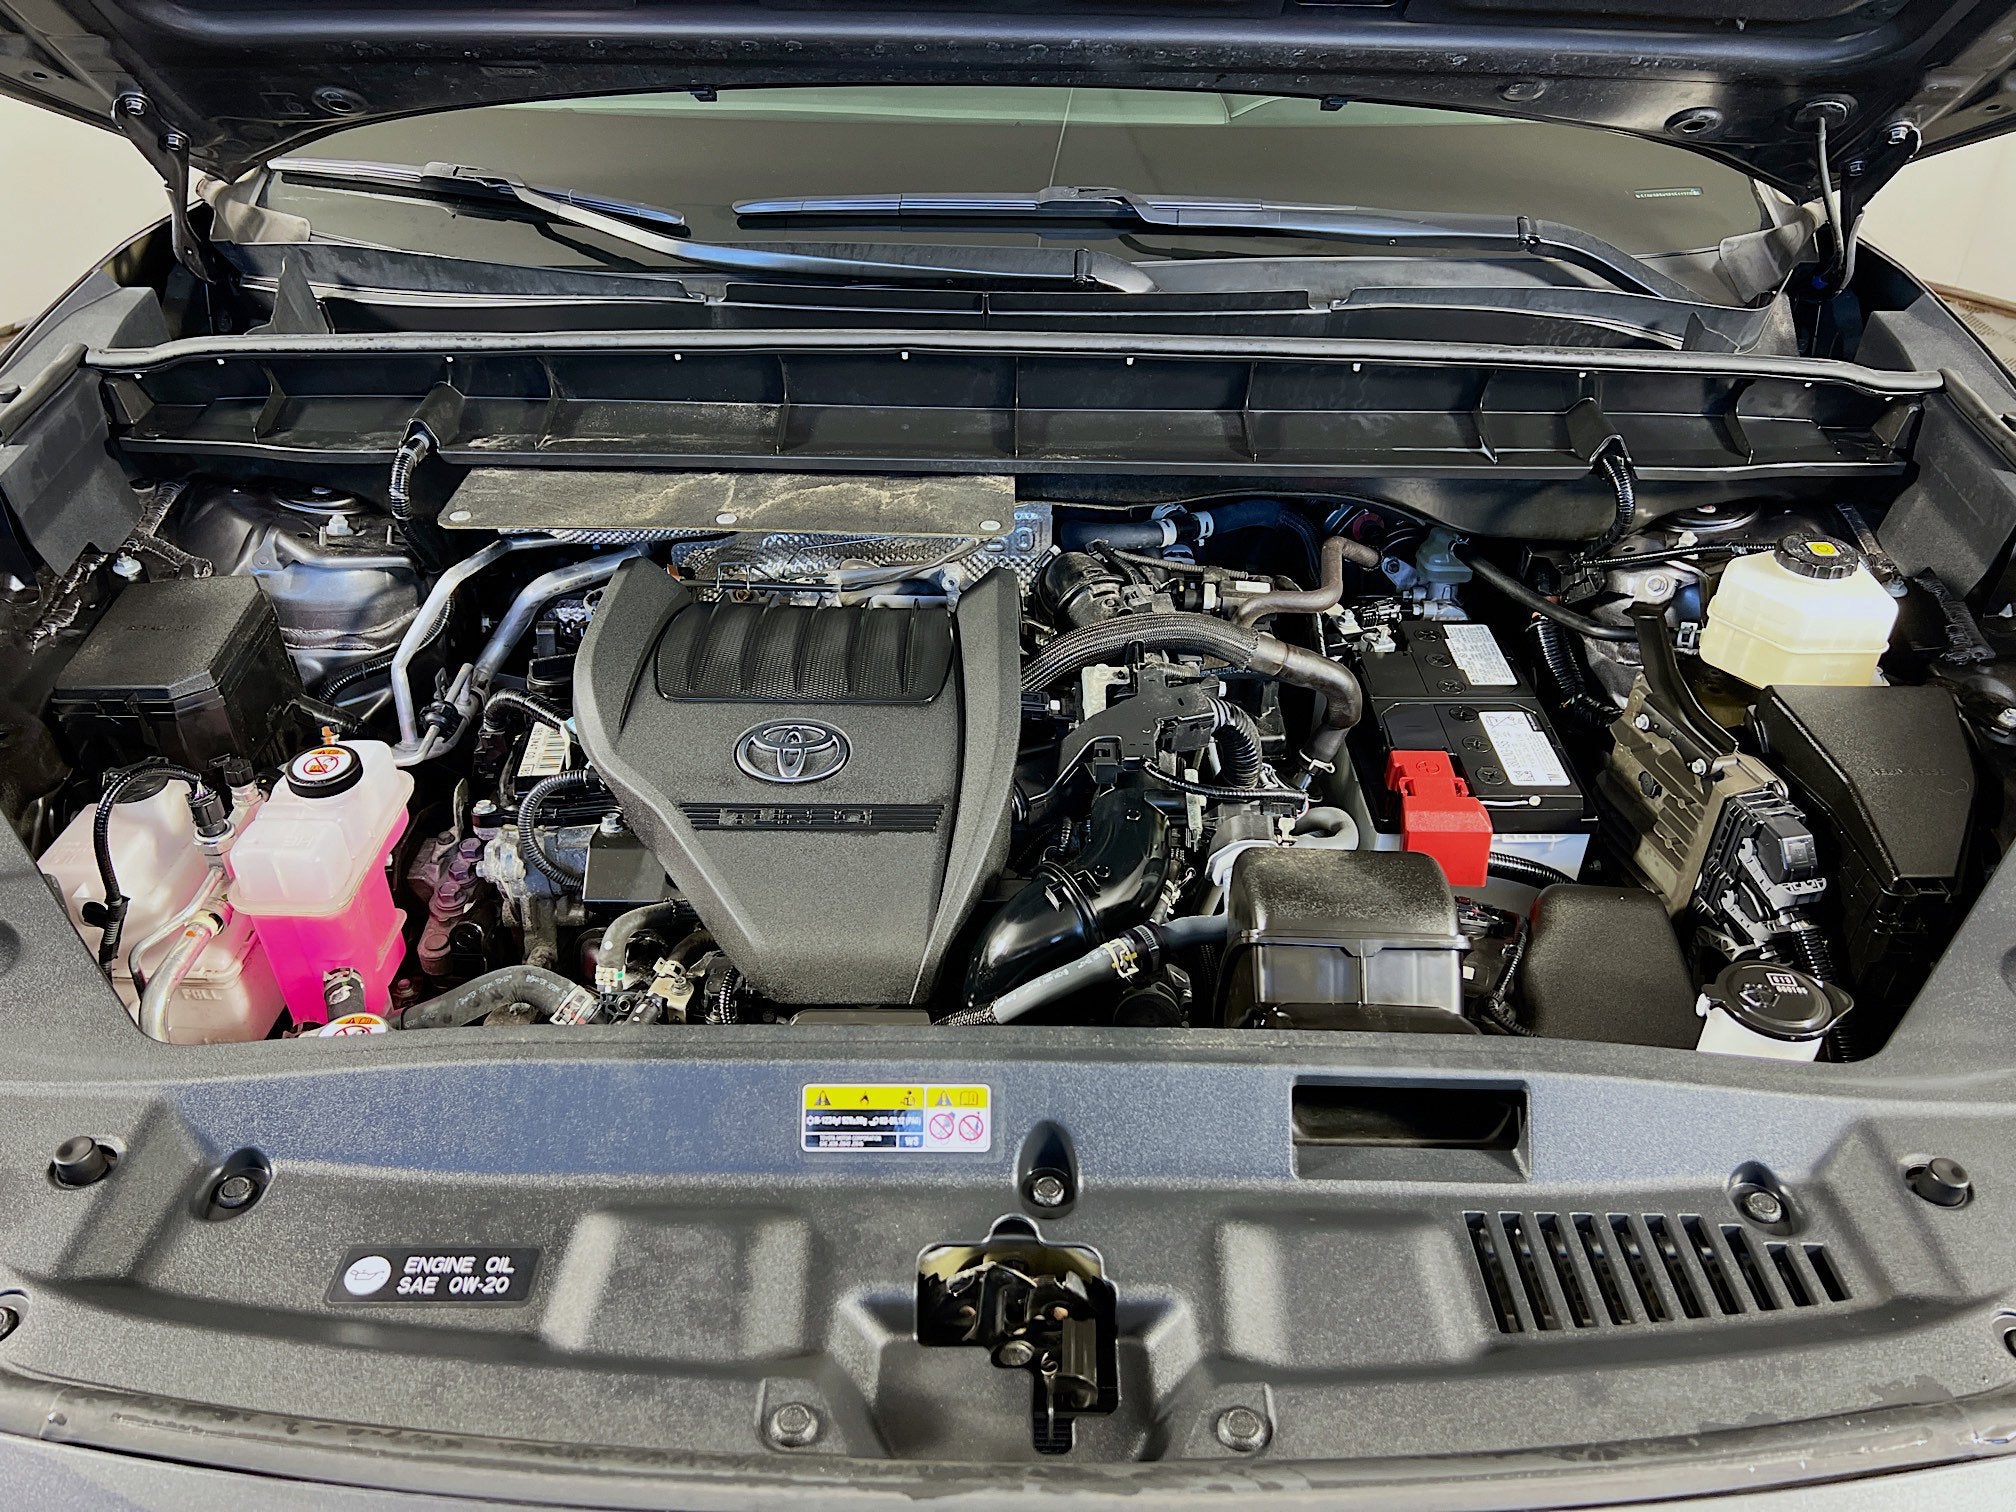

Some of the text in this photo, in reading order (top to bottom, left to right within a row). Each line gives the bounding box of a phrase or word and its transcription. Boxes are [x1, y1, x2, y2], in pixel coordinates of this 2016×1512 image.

[181, 988, 222, 1001] FULL
[403, 1256, 515, 1275] ENGINE OIL
[396, 1276, 510, 1295] SAE 0W-20
